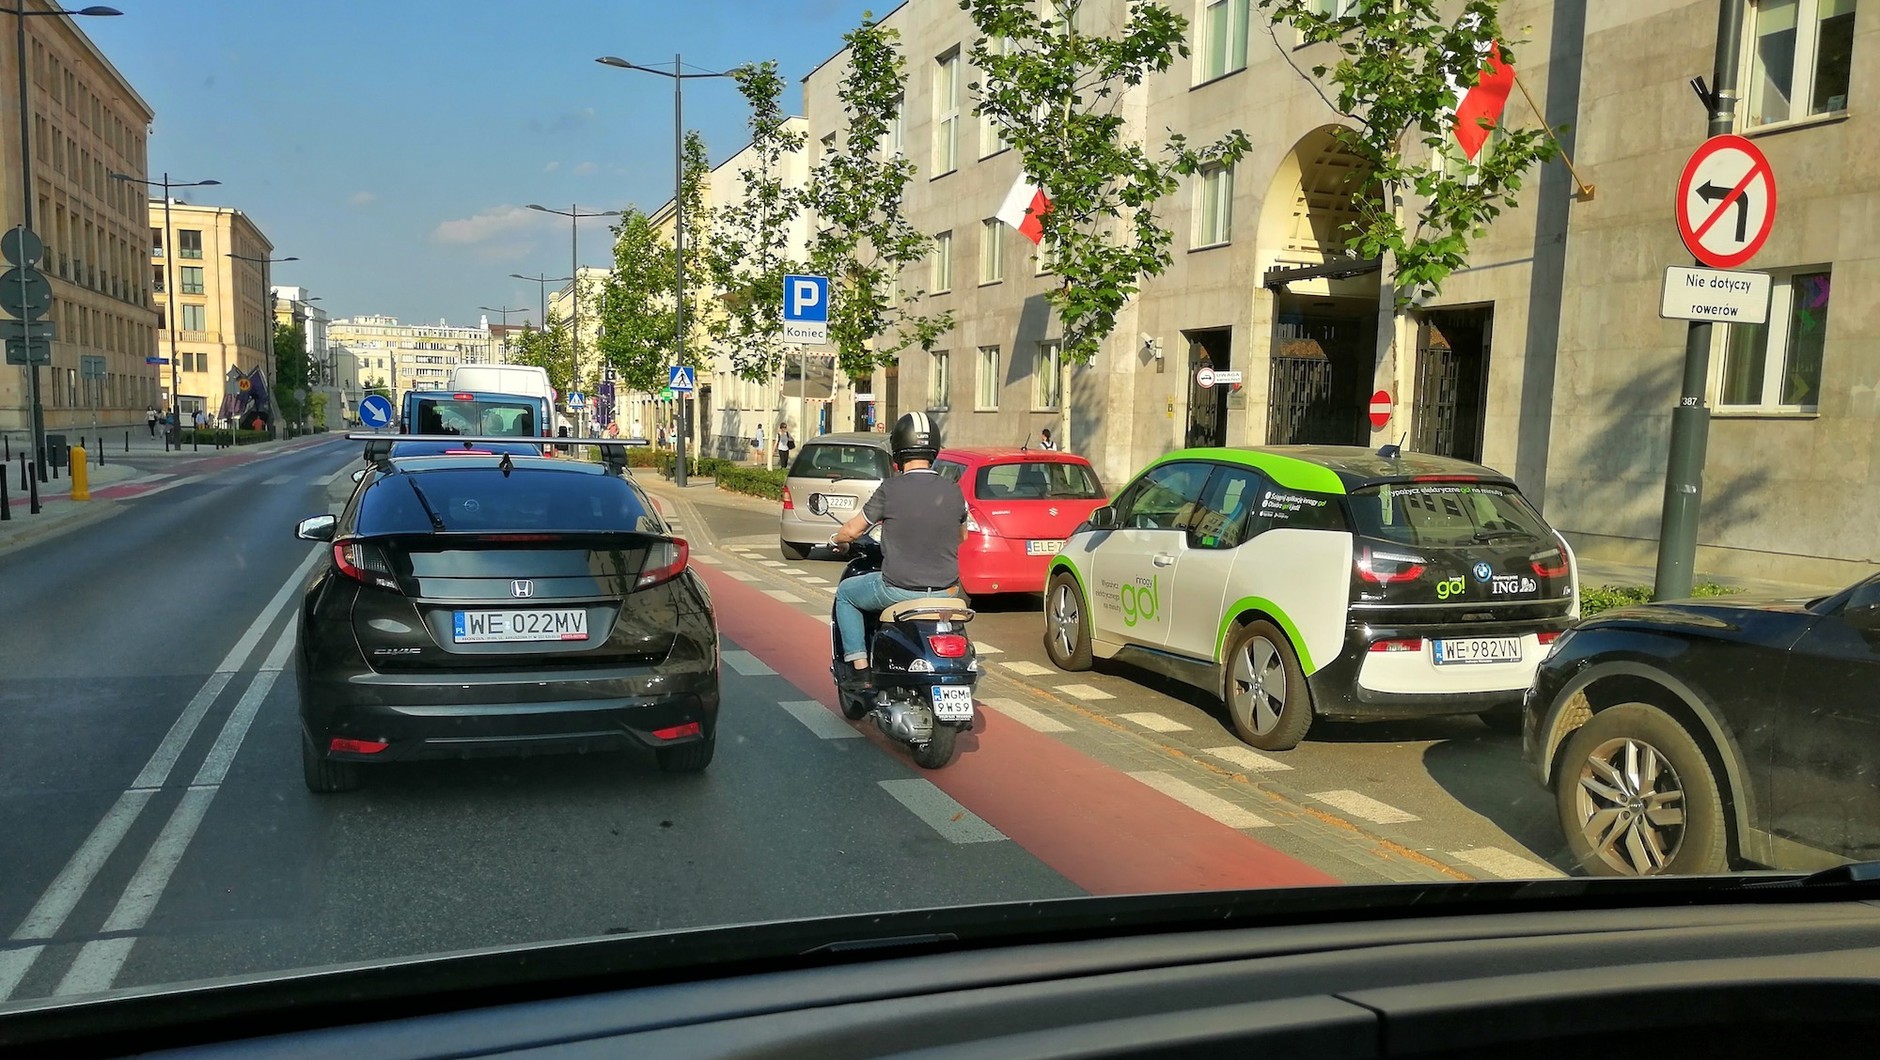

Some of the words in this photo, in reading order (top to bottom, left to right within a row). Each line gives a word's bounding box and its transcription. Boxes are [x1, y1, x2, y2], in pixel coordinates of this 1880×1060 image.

[1686, 274, 1705, 287] Nie
[1710, 276, 1751, 293] dotyczy
[794, 280, 819, 316] P
[1691, 304, 1738, 316] rowerów
[787, 327, 824, 338] Koniec
[1683, 397, 1697, 406] 387
[830, 498, 853, 507] 2229X
[1033, 541, 1054, 552] ELE
[1437, 575, 1465, 599] go!
[1492, 581, 1519, 594] ING
[1121, 574, 1160, 627] go!
[470, 614, 503, 634] WE
[512, 612, 583, 633] 022MV
[1446, 641, 1466, 659] WE
[1471, 640, 1518, 658] 982VN
[942, 689, 966, 699] WGM
